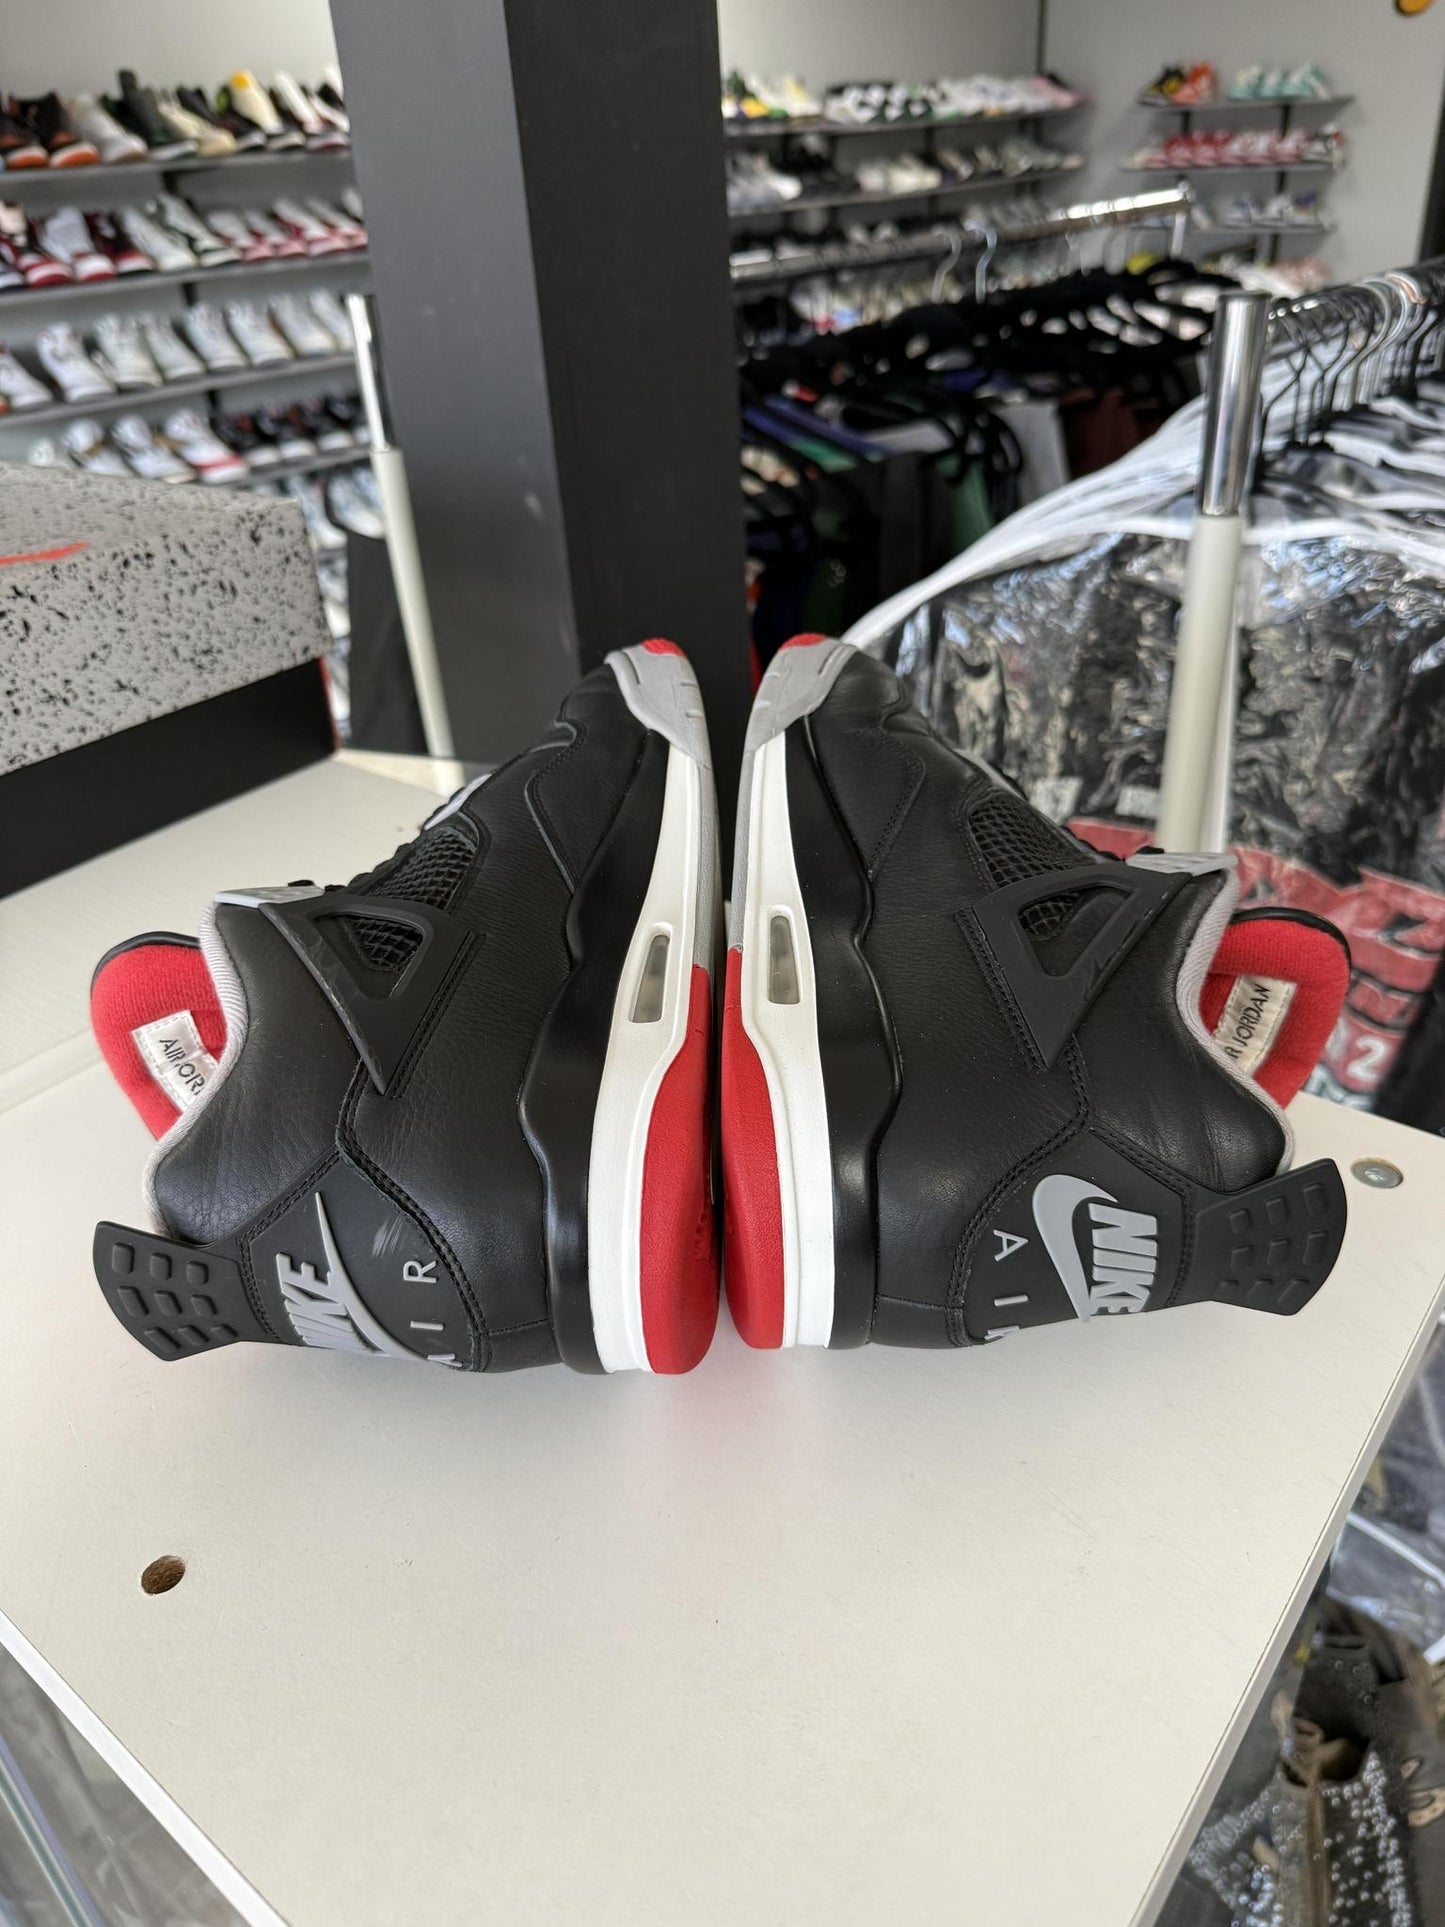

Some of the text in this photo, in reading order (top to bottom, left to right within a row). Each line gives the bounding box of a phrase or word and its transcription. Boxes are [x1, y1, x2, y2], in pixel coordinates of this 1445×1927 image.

[1232, 983, 1271, 1047] JORDAN
[159, 1039, 186, 1063] AIR
[1088, 1202, 1157, 1316] NIKE
